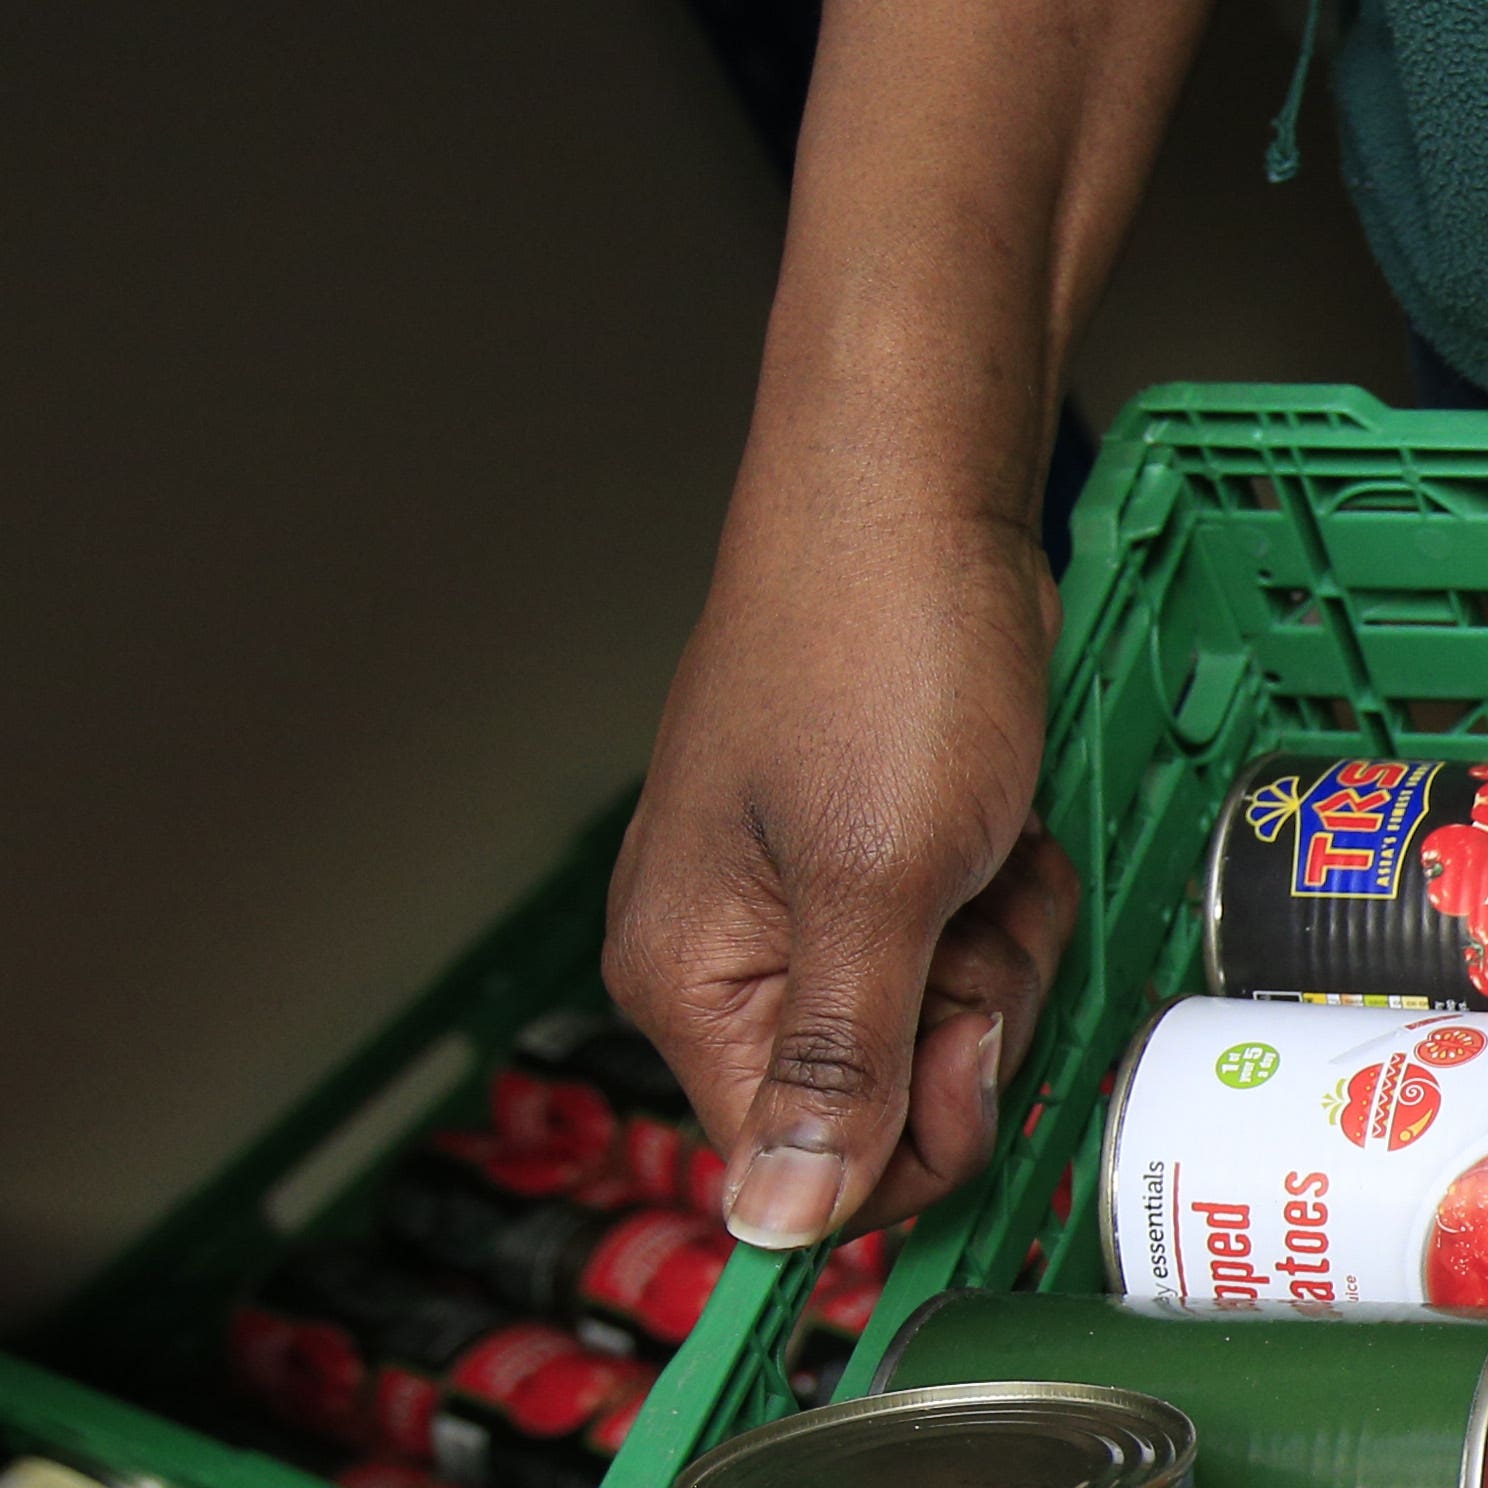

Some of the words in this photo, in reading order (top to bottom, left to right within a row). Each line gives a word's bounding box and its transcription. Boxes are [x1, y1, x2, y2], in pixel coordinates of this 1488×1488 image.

[1304, 761, 1409, 887] TRS
[1376, 837, 1397, 887] ASIA'S
[1143, 1161, 1168, 1279] essentials
